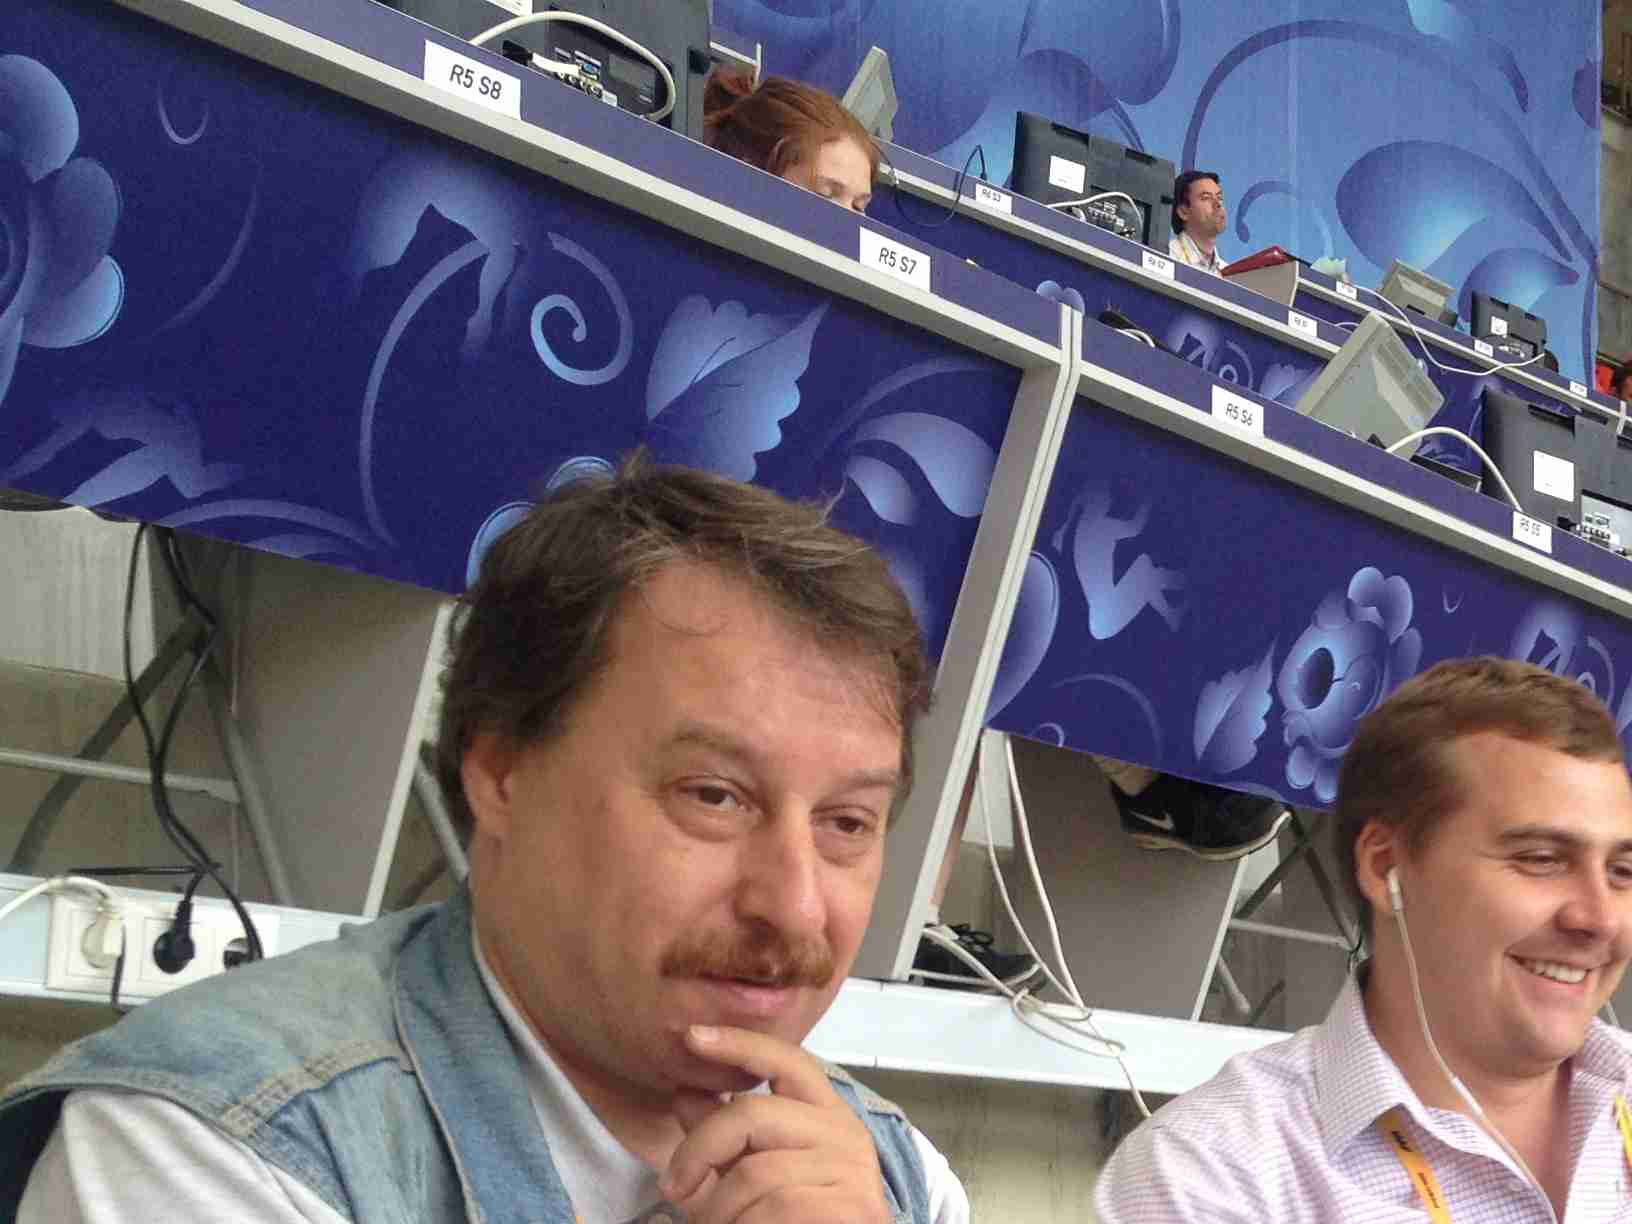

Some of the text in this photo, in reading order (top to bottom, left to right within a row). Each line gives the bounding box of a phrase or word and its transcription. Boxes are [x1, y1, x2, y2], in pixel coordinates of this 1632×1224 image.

[449, 63, 502, 100] R5 S8
[878, 247, 918, 275] R5 S7
[1225, 402, 1239, 420] R5
